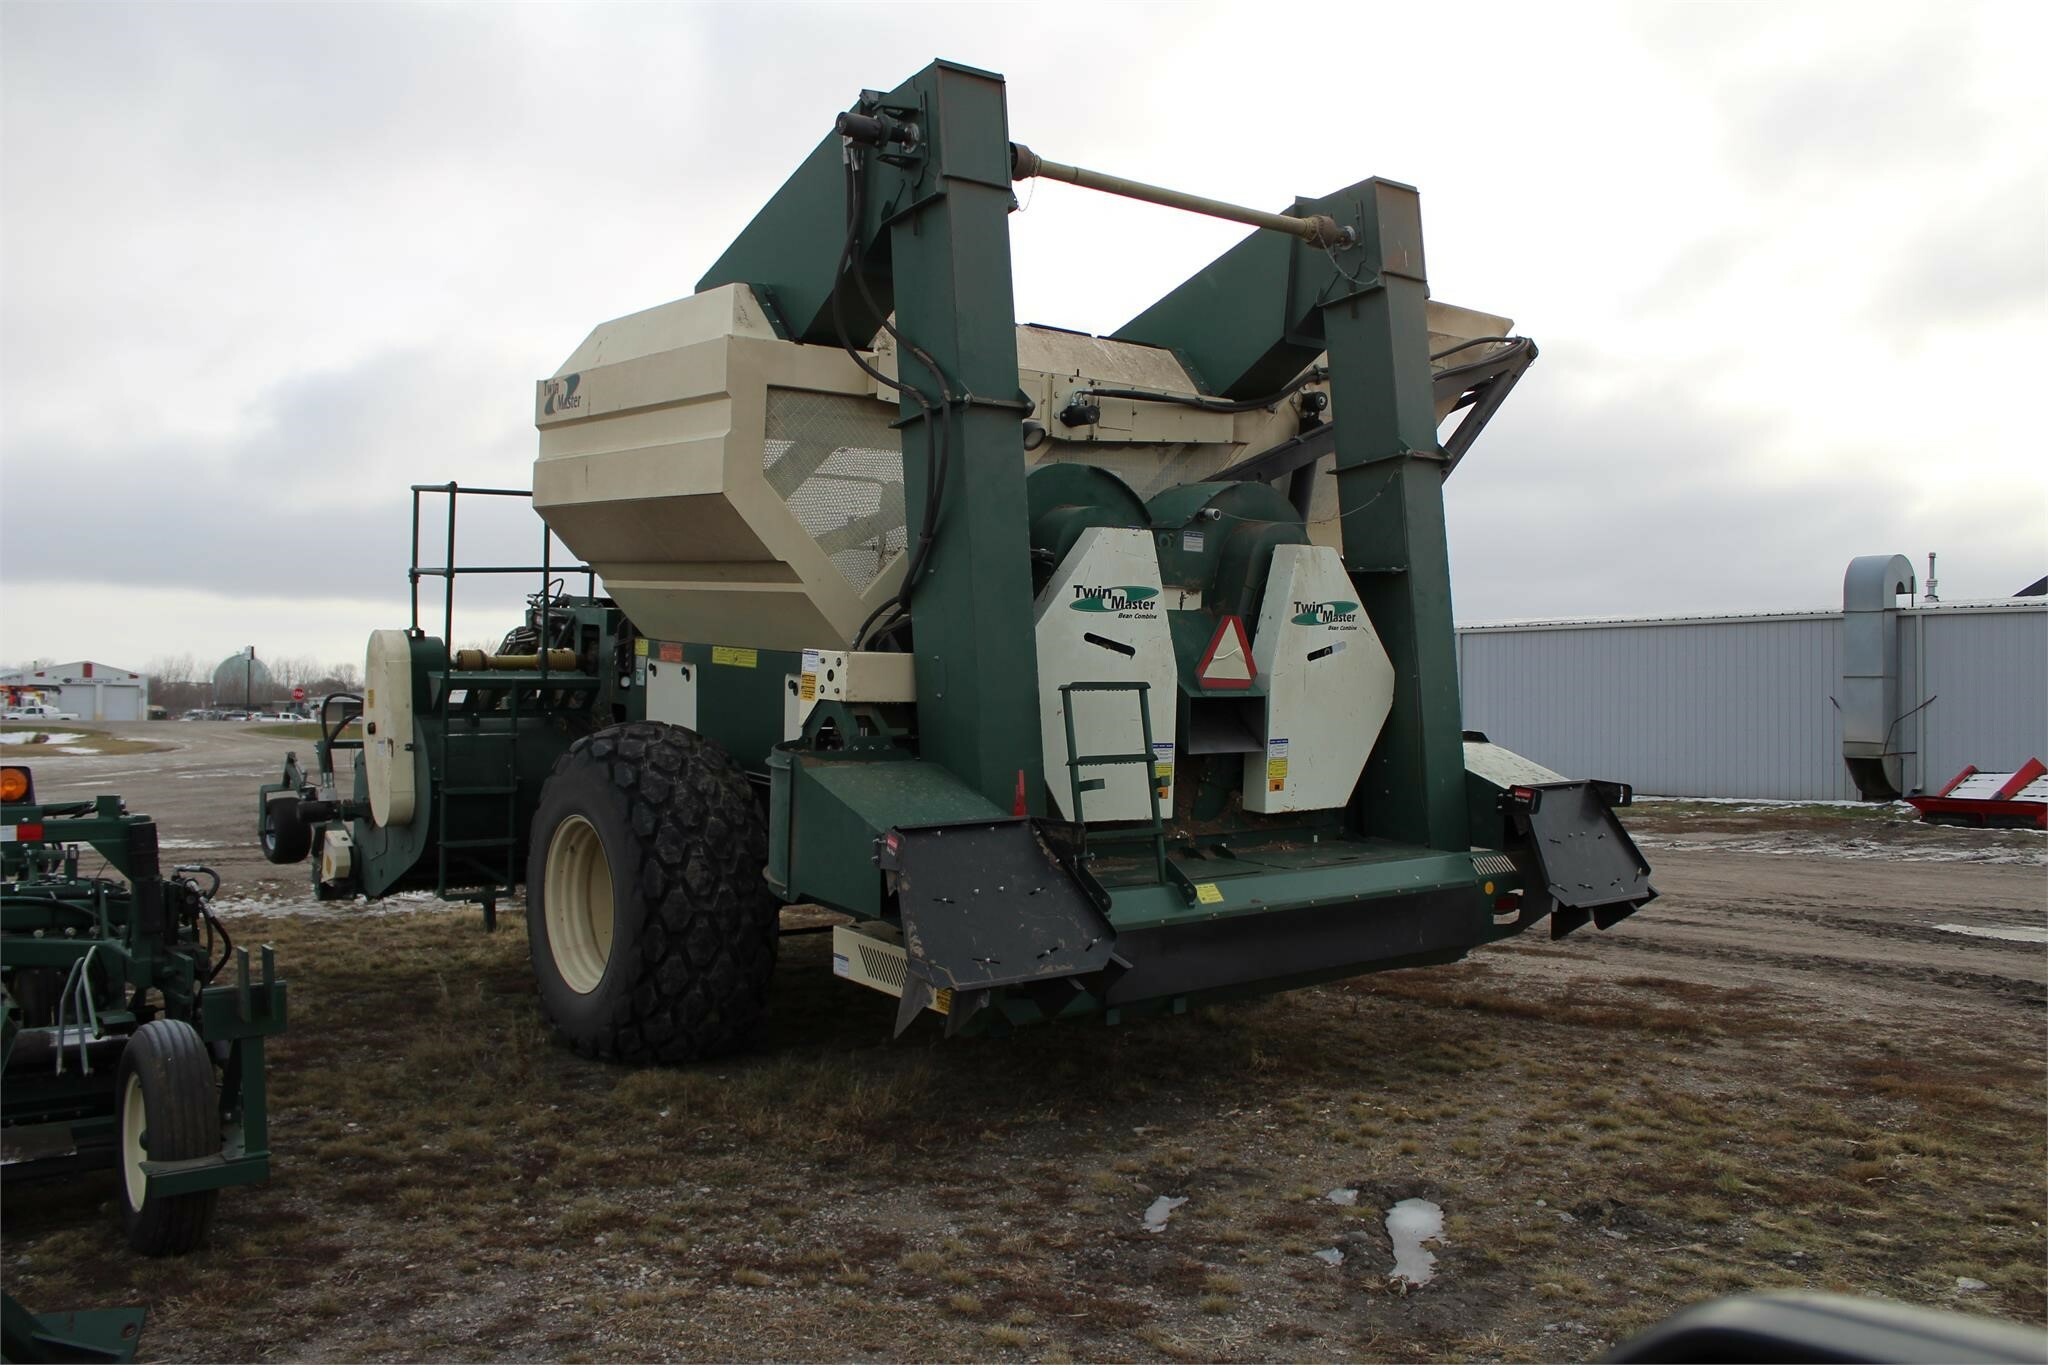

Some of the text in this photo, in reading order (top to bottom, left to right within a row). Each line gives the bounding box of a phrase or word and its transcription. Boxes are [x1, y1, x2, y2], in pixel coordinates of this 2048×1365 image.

[557, 394, 581, 411] Master
[1073, 585, 1112, 599] Twin
[1111, 596, 1155, 610] Master
[1293, 601, 1324, 614] Twin
[1322, 610, 1356, 622] Master
